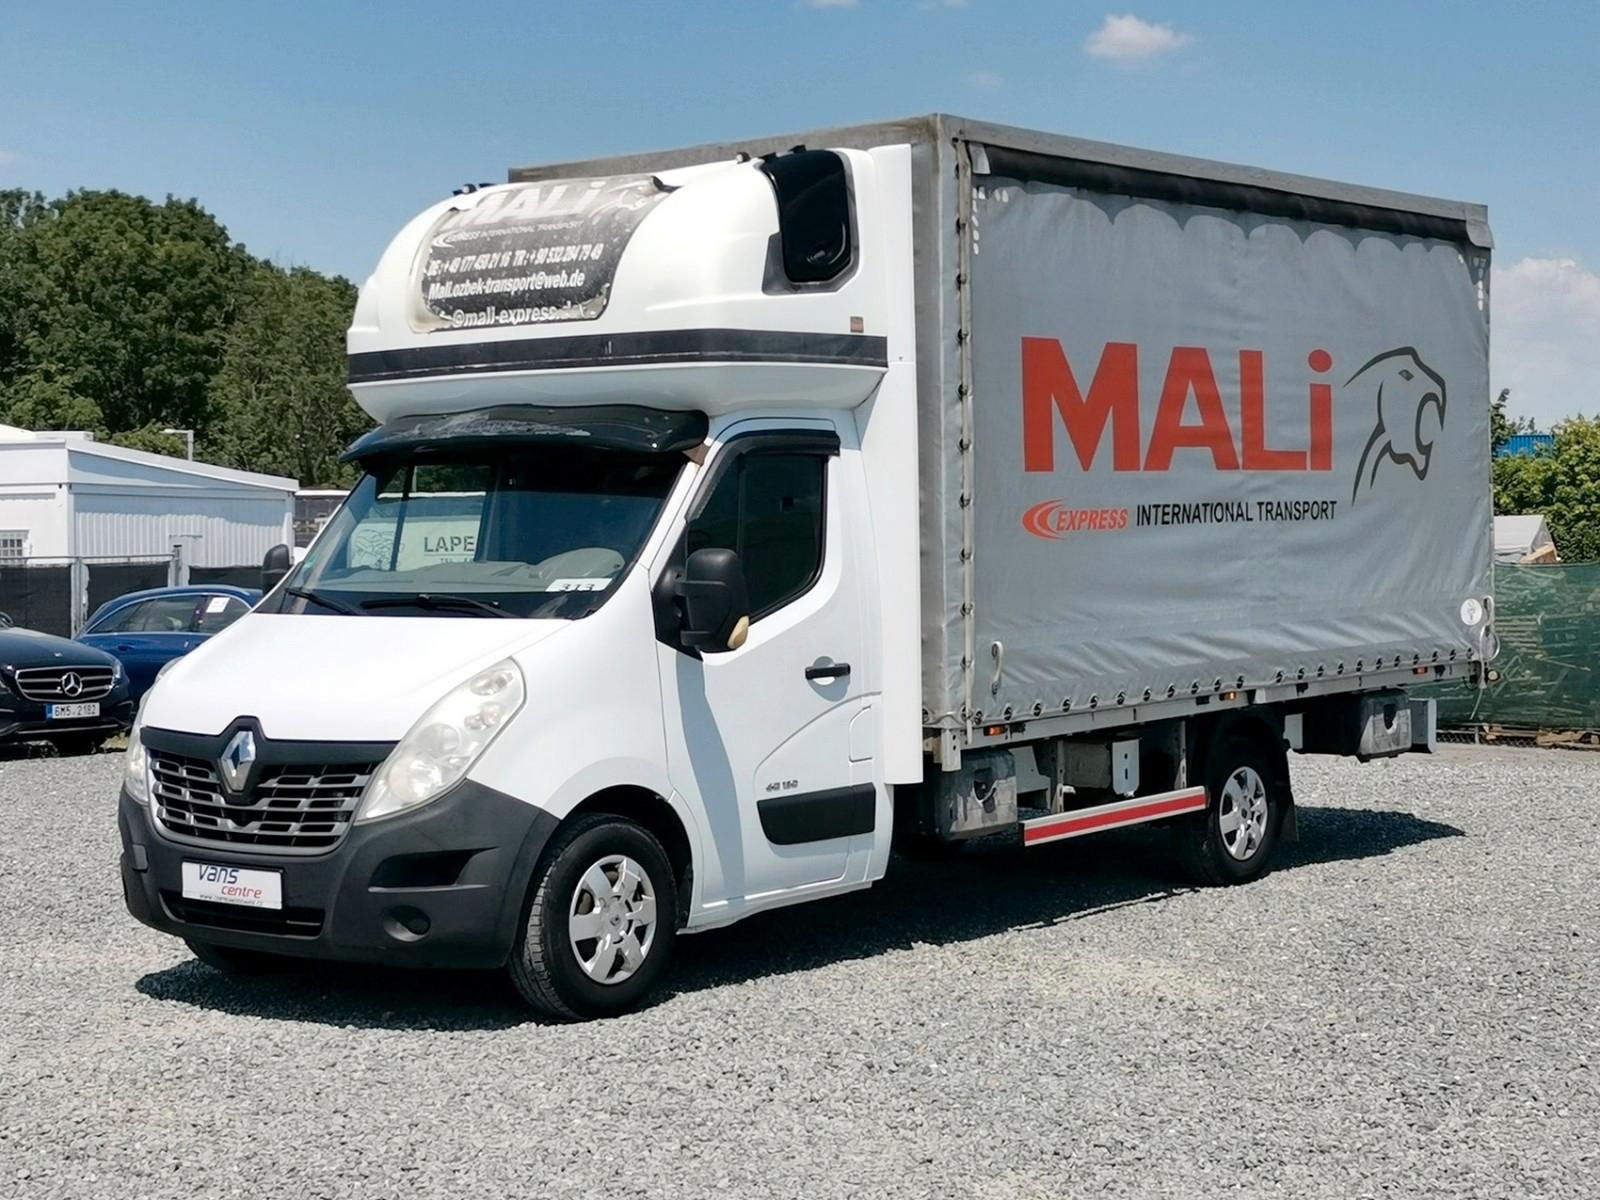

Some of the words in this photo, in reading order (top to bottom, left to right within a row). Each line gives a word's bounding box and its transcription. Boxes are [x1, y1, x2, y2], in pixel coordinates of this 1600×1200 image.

[1022, 336, 1333, 473] MALi
[1055, 508, 1128, 531] EXPRESS
[1136, 502, 1254, 527] INTERNATIONAL
[1257, 500, 1338, 522] TRANSPORT
[221, 885, 262, 899] centre
